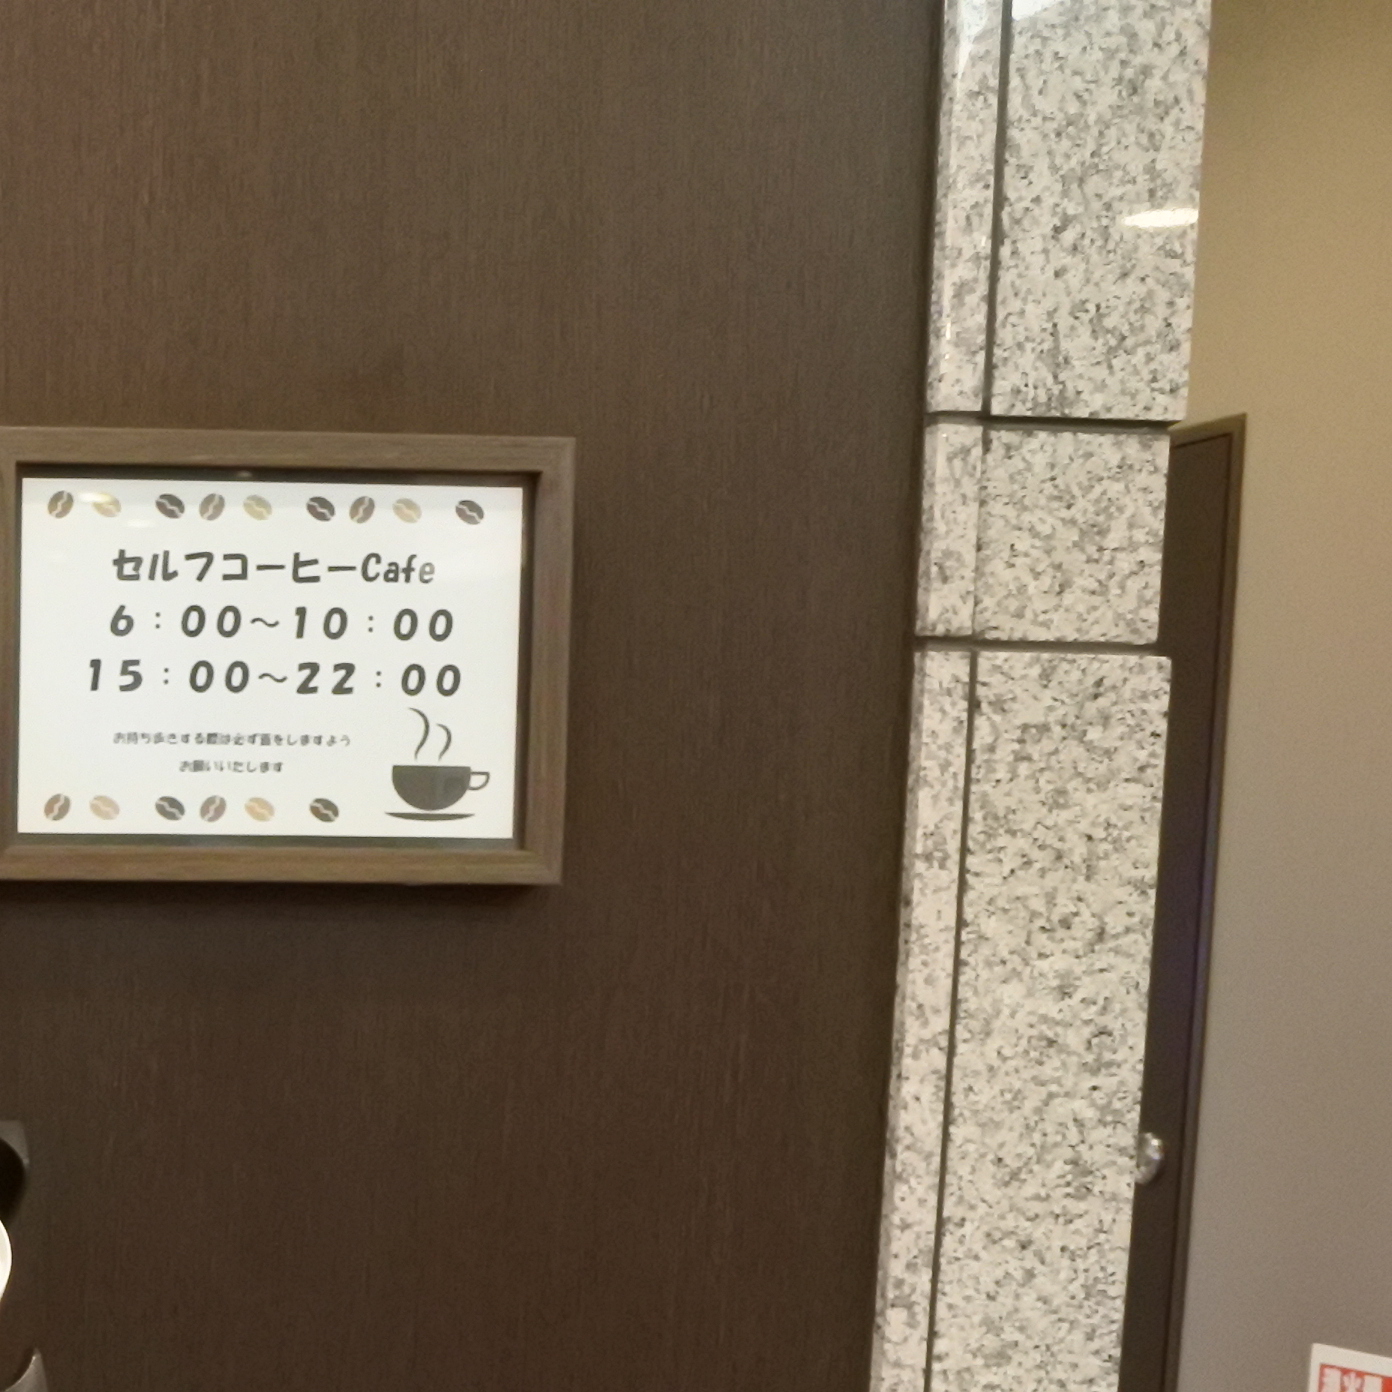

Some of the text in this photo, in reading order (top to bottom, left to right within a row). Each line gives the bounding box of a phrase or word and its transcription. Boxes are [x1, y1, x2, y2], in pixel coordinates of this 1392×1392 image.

[112, 549, 435, 584] セルフコーヒーCafe
